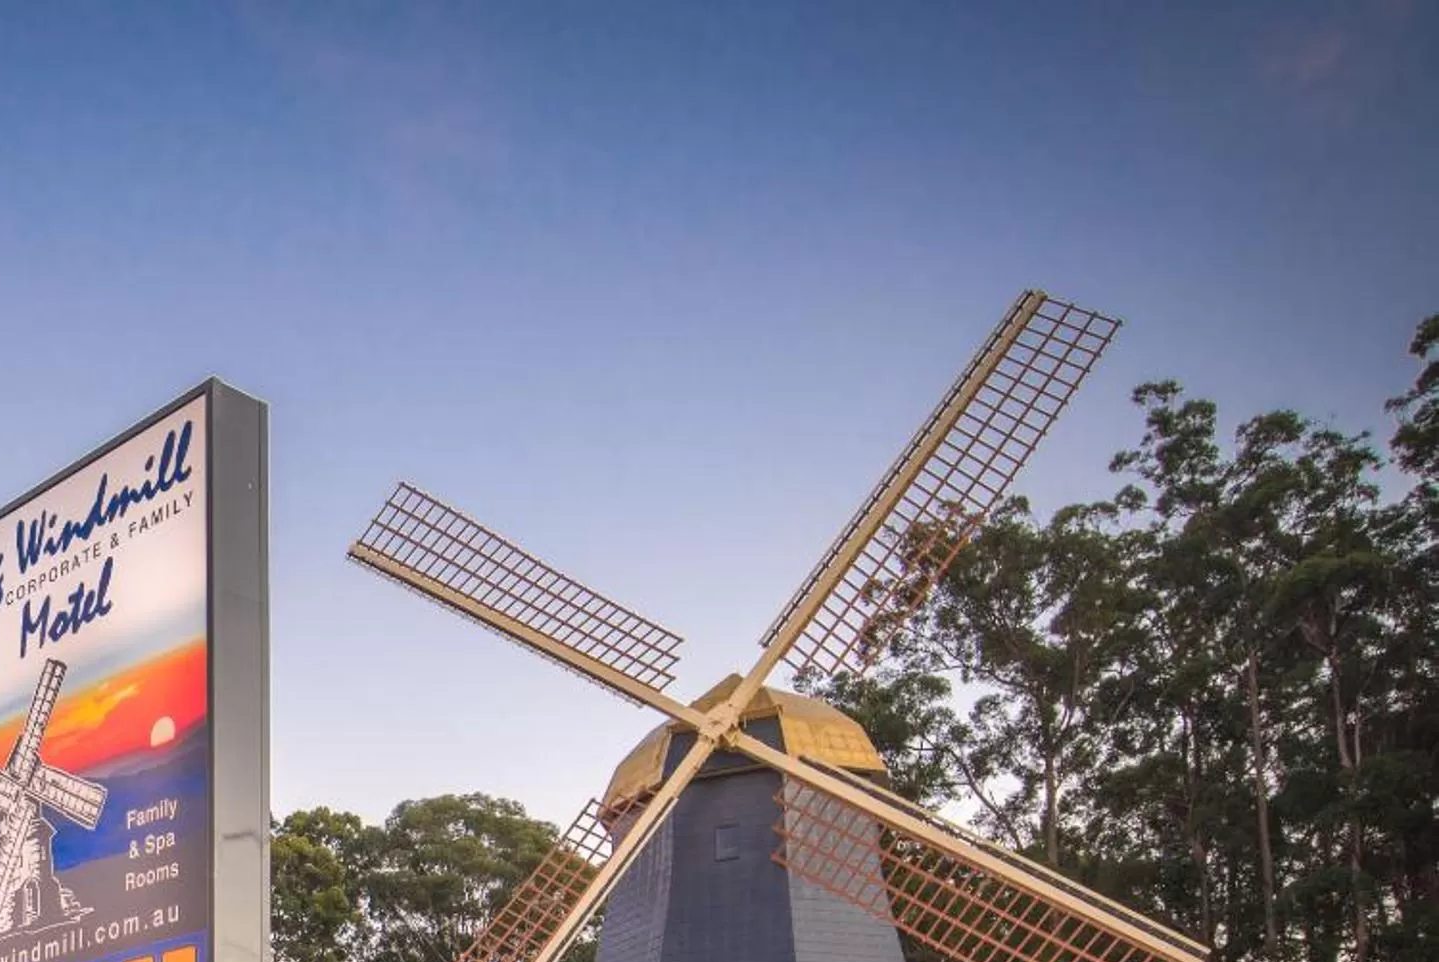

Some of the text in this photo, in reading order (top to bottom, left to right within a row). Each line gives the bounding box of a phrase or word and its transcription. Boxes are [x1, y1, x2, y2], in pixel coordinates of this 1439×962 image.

[16, 420, 193, 575] Windmill
[5, 491, 194, 606] CORPORATE & FAMILY
[20, 556, 114, 659] Motel
[126, 798, 178, 830] Family
[129, 832, 176, 859] & Spa
[125, 862, 180, 891] Rooms
